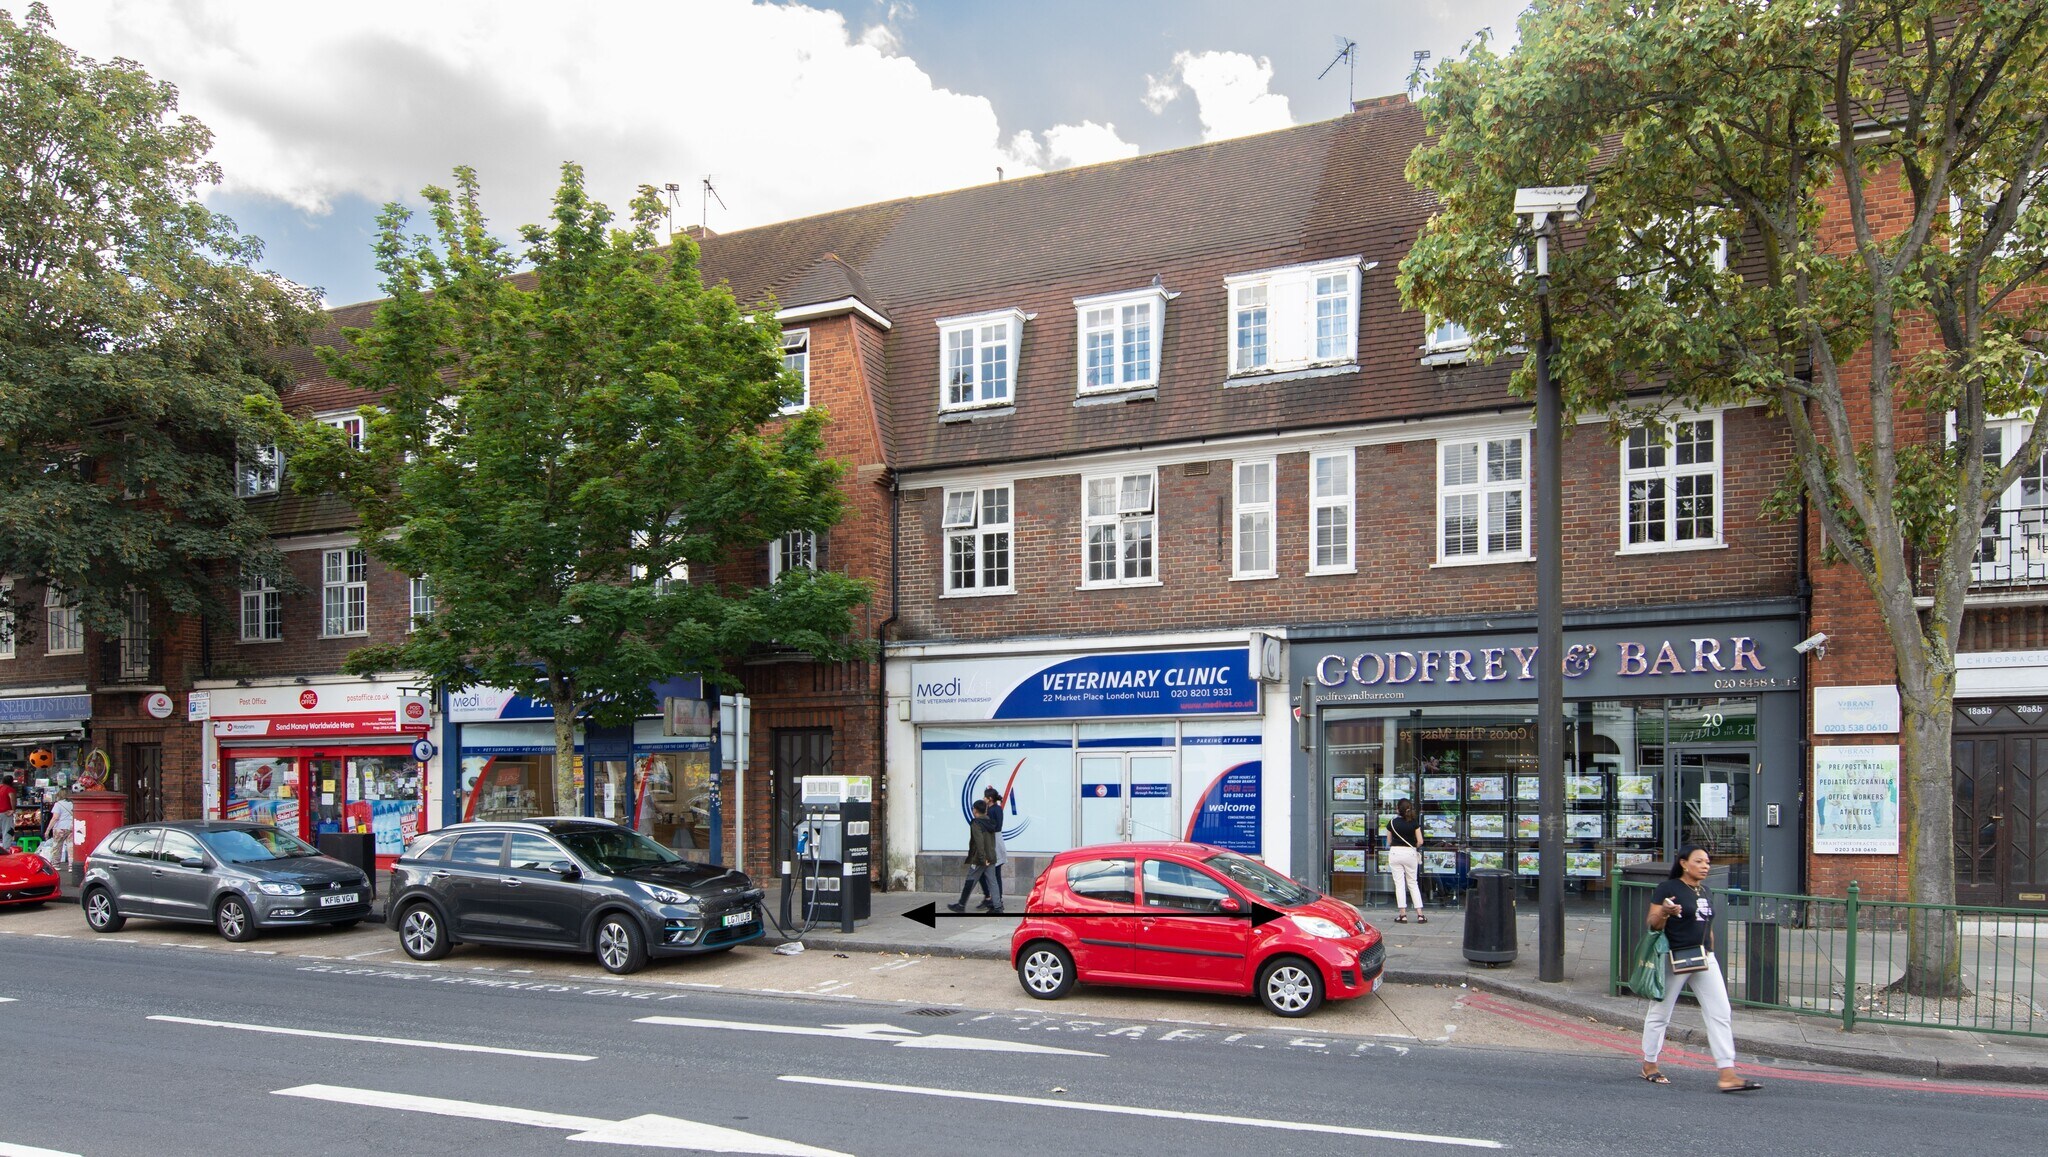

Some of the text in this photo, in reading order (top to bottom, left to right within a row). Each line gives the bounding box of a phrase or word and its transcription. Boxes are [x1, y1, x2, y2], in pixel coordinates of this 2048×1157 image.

[1315, 636, 1766, 687] GODFREY & BARR
[1043, 667, 1230, 691] VETERINARY CLINIC
[1714, 678, 1736, 689] 020
[1739, 677, 1767, 688] 8458
[346, 693, 389, 702] postoffice.co.uk
[1043, 690, 1160, 702] 22 Market Place London NW11
[1171, 688, 1232, 698] 020 8201 9331
[47, 697, 86, 711] STORE
[1180, 700, 1254, 710] www.medivet.co.uk
[1968, 705, 2043, 715] 18a&b 20a&b
[1702, 713, 1723, 727] 20
[275, 723, 290, 731] Send
[291, 723, 308, 731] Money
[309, 721, 340, 730] Worldwide
[340, 721, 355, 729] Here
[1848, 724, 1864, 732] 538
[1223, 785, 1241, 793] OPEN
[1209, 802, 1256, 812] welcome
[324, 894, 355, 905] KF16 VGV
[431, 975, 573, 992] VEHICLES
[581, 988, 688, 1001] ONLY
